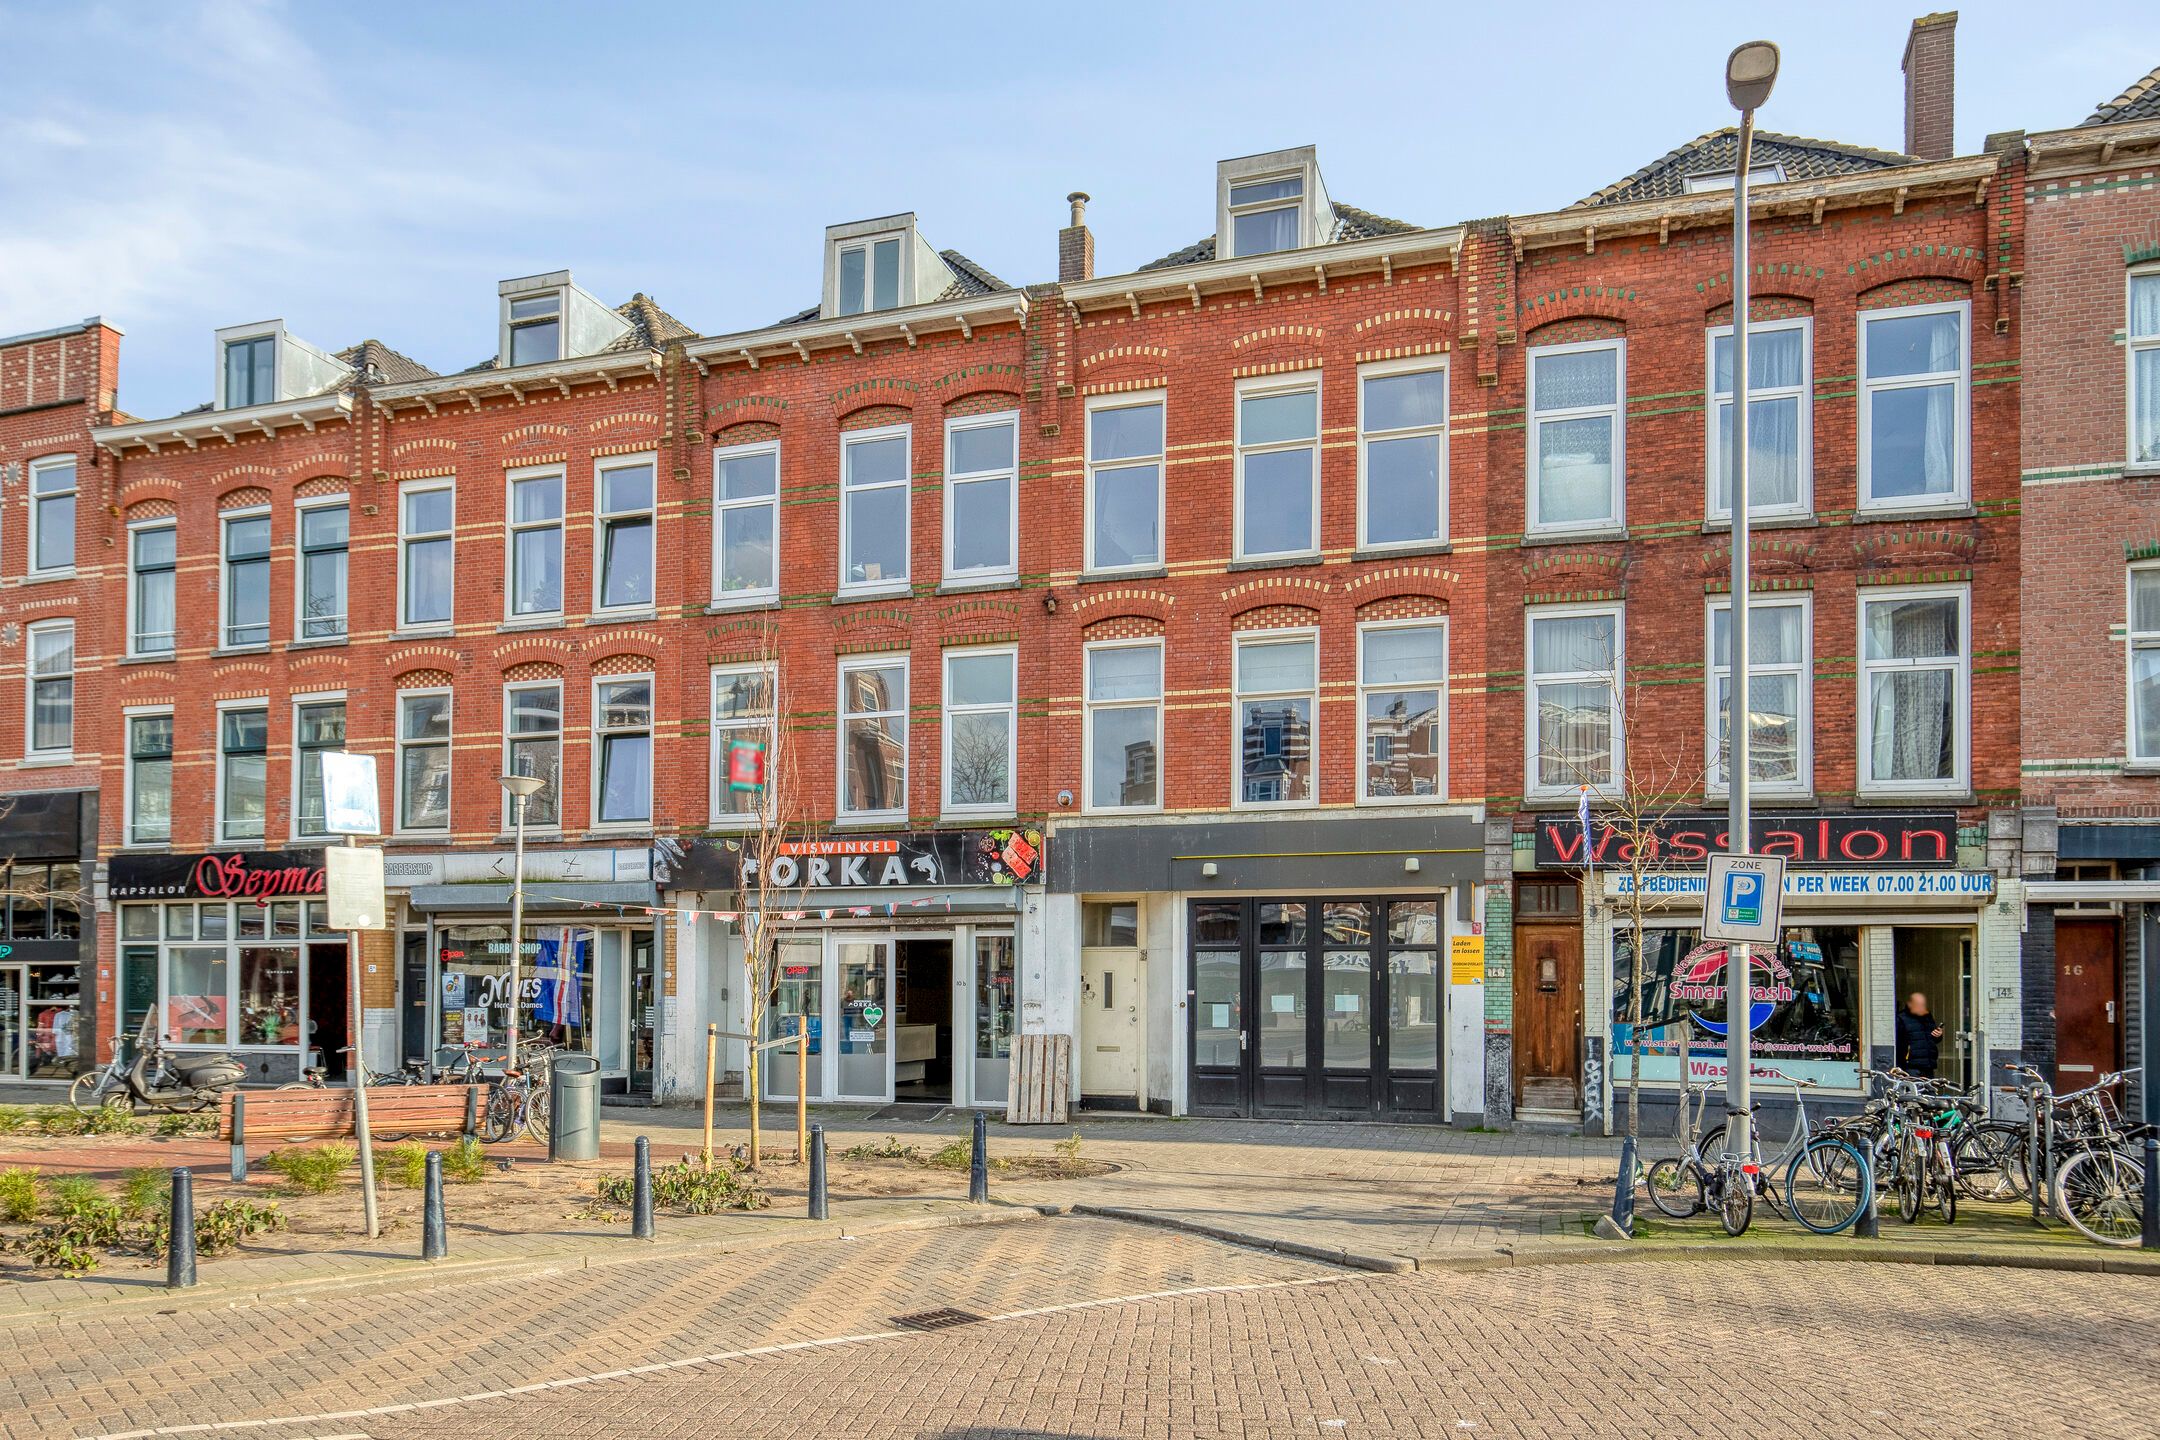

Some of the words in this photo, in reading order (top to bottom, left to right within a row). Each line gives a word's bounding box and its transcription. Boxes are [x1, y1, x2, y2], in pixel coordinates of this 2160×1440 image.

[789, 841, 891, 855] VISWINKEL
[384, 862, 433, 875] BARBERSHOP
[769, 855, 910, 887] ORKA
[1730, 860, 1762, 870] ZONE
[195, 853, 327, 908] Seyma
[1618, 876, 1706, 892] ZEFBEDIENI
[1797, 876, 1824, 892] PER
[1830, 876, 1870, 892] WEEK
[1877, 875, 1914, 892] 07.00
[1918, 875, 1956, 892] 21.00
[1960, 875, 1992, 892] UUR
[110, 885, 187, 896] KAPSALON
[488, 942, 542, 954] BARBSHOP
[786, 966, 809, 975] OPEN
[2064, 964, 2084, 976] 16
[1669, 981, 1793, 1001] Smarash
[494, 1001, 509, 1009] Here
[520, 1001, 544, 1009] Dames
[1624, 1039, 1728, 1050] ww.smarwash.nl
[1750, 1043, 1851, 1054] fo@smart-wash.nl
[1689, 1061, 1781, 1079] Waslon
